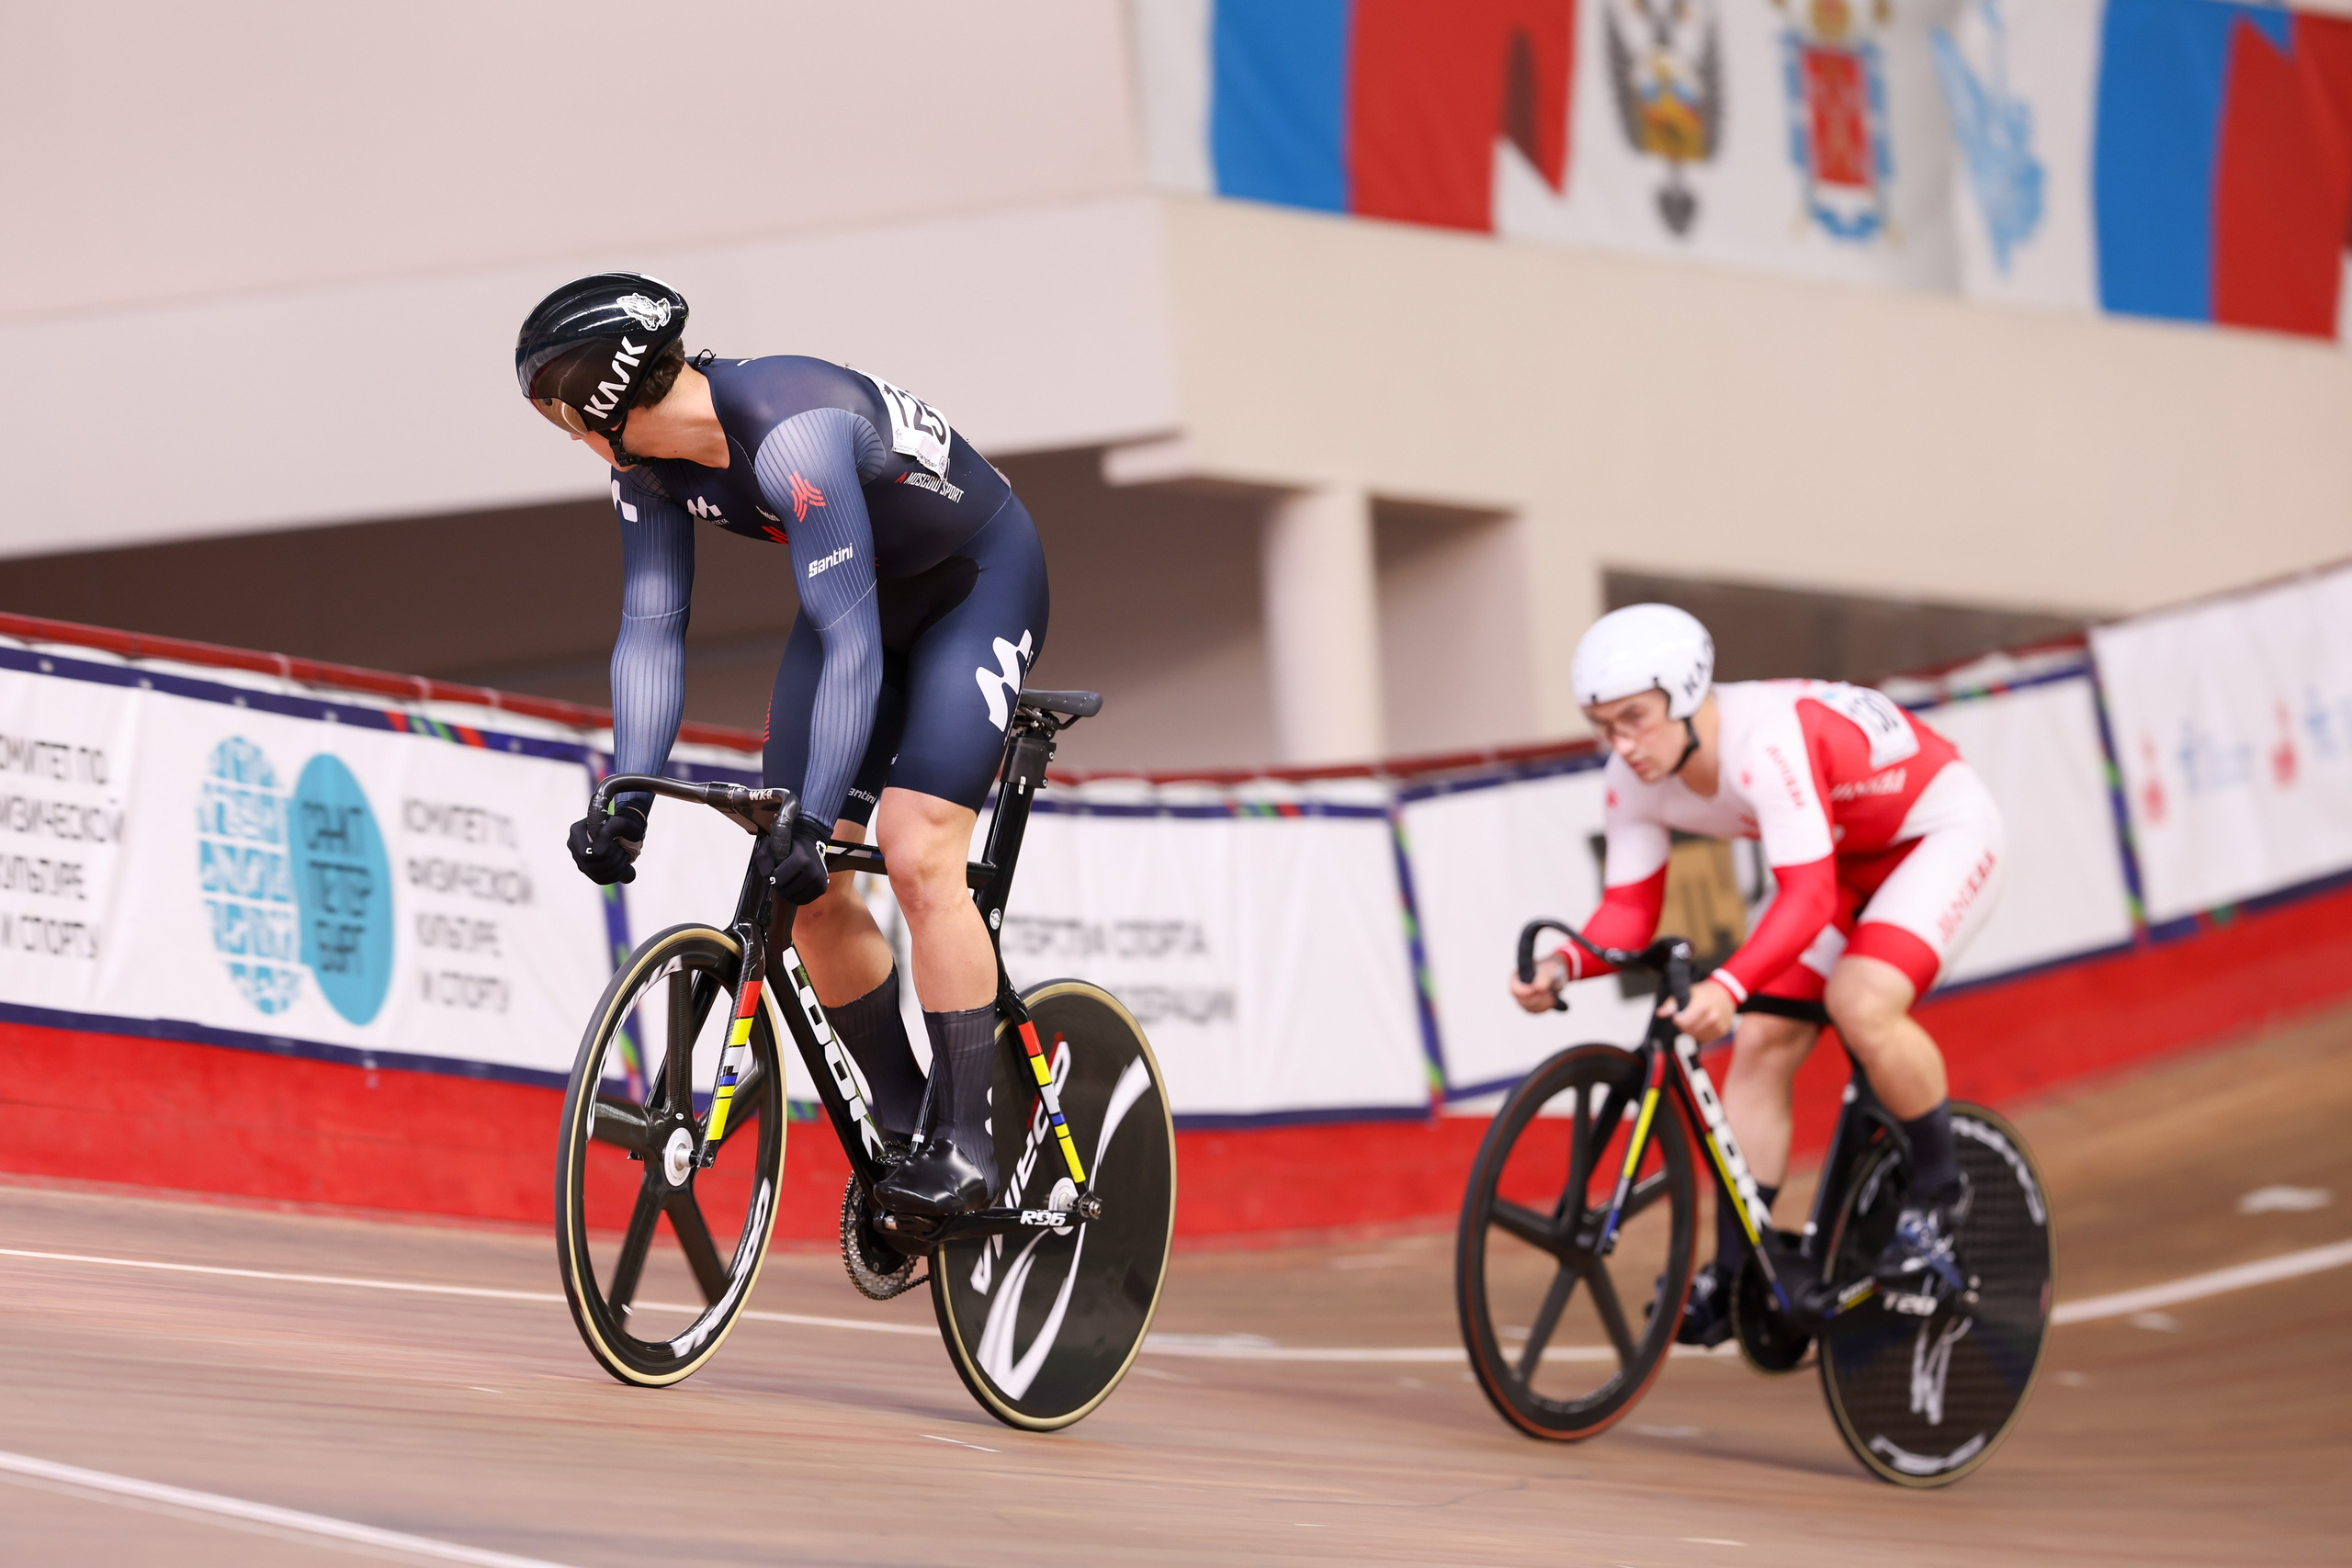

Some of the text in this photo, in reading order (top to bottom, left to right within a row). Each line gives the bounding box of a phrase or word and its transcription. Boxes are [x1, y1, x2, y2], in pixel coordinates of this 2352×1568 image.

[582, 335, 648, 420] KASK
[903, 471, 965, 504] MOSCOW SPORT
[808, 542, 854, 579] Santini
[0, 735, 71, 781] ОМИТЕТ
[847, 787, 878, 805] antini
[0, 794, 125, 846] ИЗИЧЕСКОЙ
[0, 853, 86, 901] УЛЬТУРЕ
[782, 945, 886, 1161] LOOK
[1674, 1032, 1777, 1235] LOOK
[1019, 1209, 1068, 1227] R96
